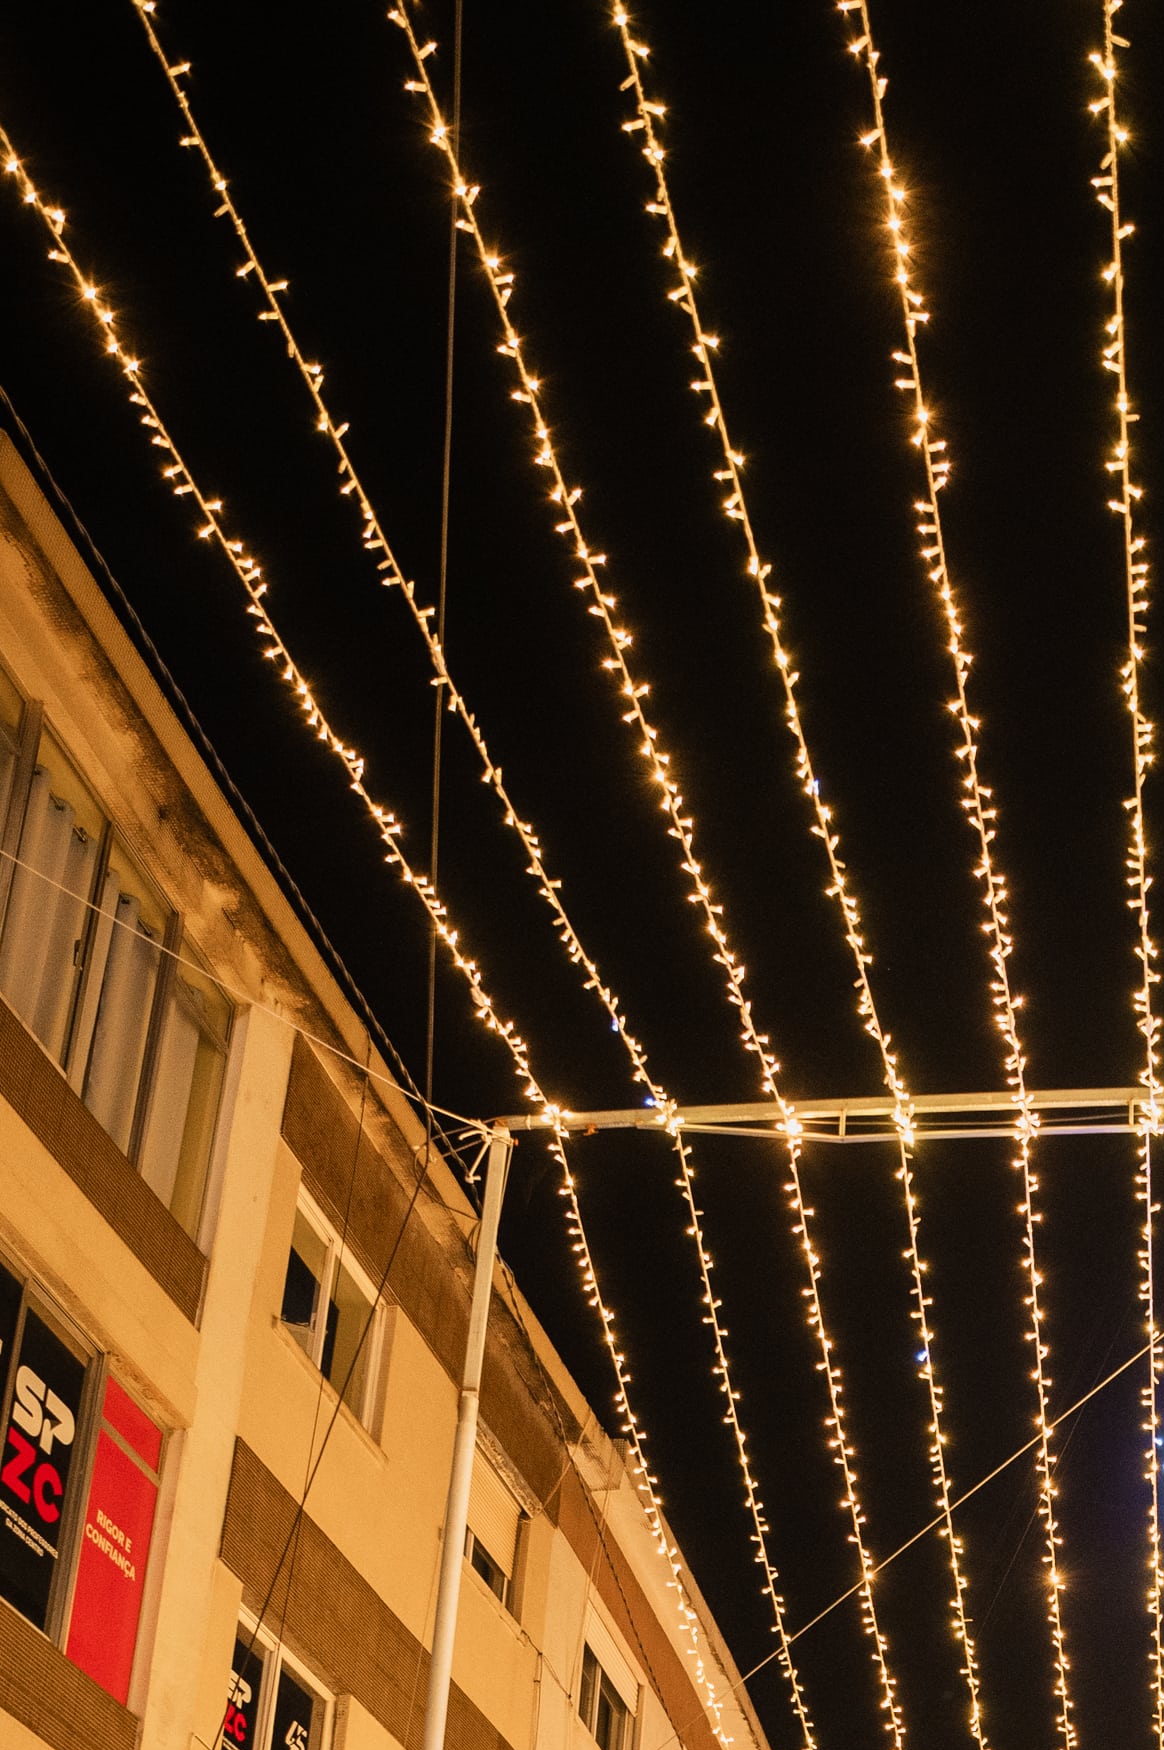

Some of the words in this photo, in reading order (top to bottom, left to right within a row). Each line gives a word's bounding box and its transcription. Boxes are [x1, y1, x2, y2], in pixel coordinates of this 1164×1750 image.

[1, 1427, 63, 1523] ZC
[85, 1523, 136, 1581] CONFIANÇA
[96, 1509, 125, 1546] RIGOR
[124, 1536, 132, 1553] E
